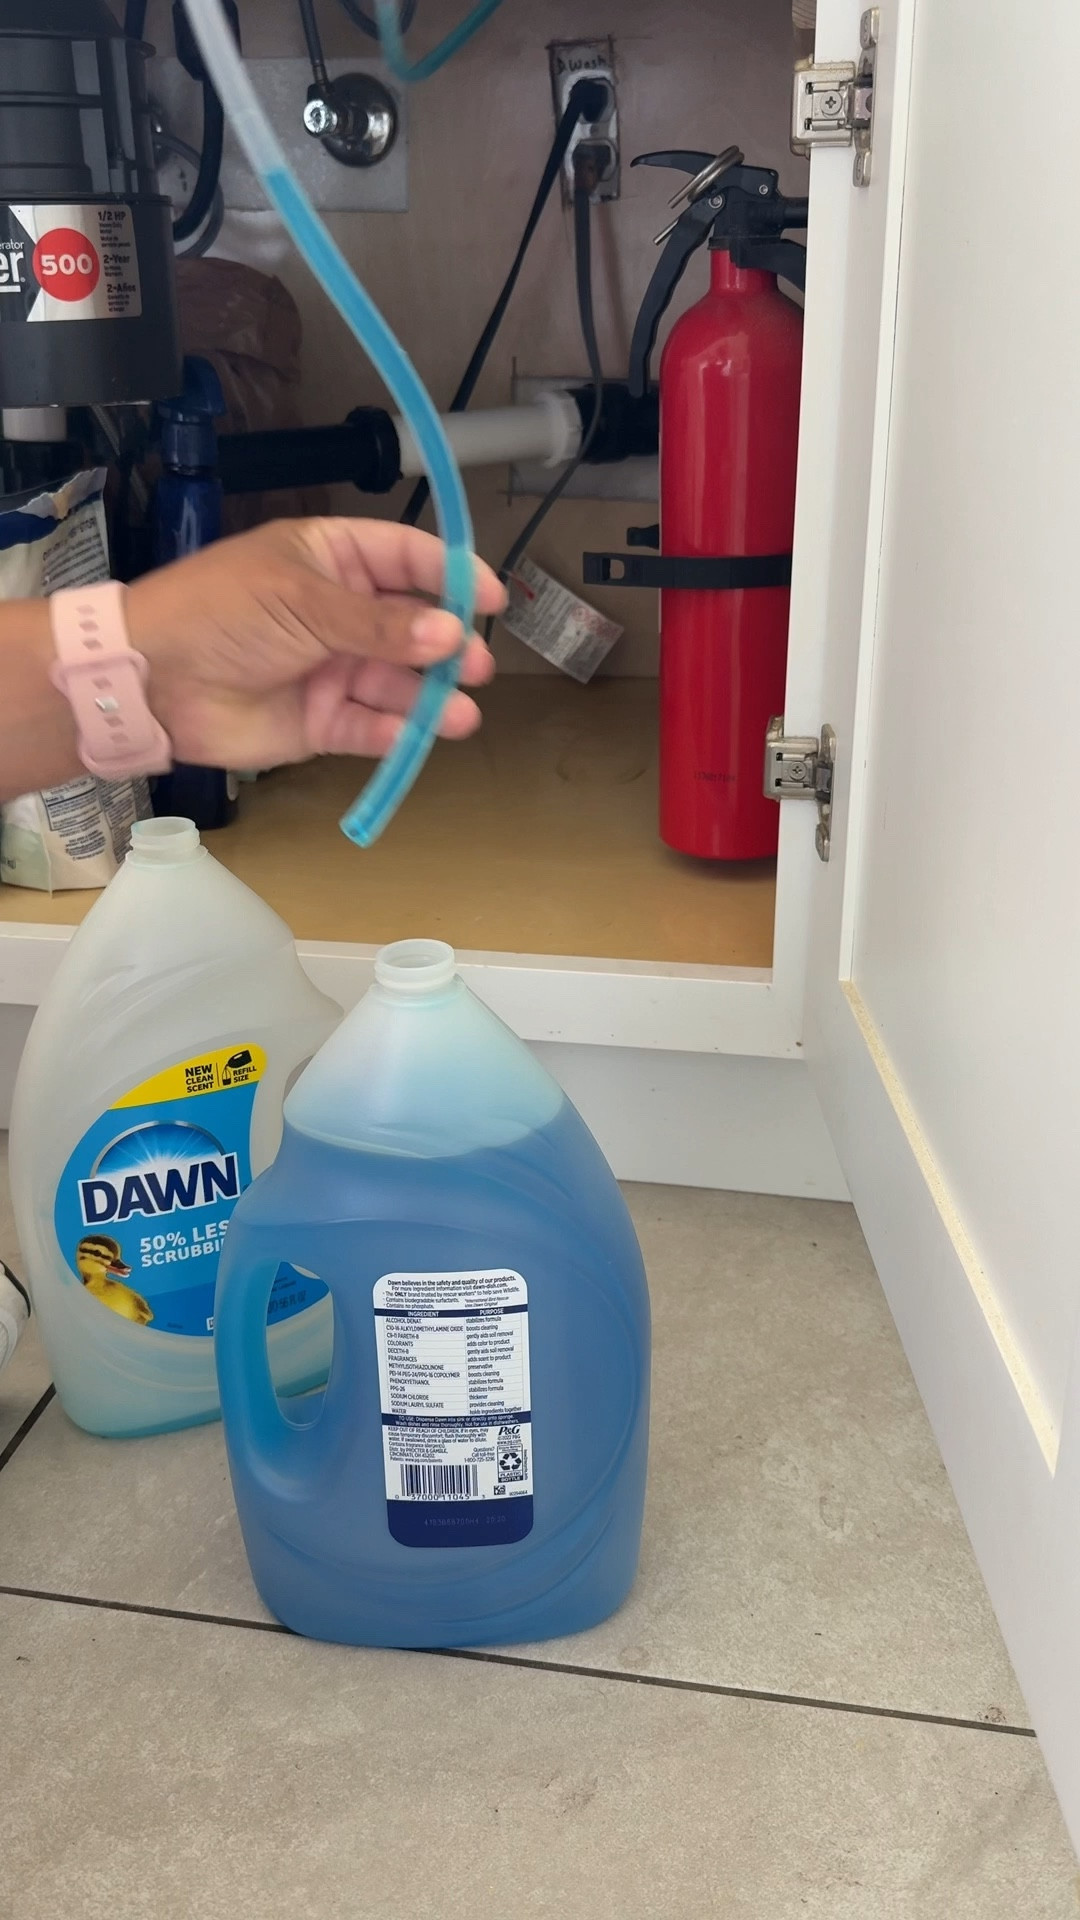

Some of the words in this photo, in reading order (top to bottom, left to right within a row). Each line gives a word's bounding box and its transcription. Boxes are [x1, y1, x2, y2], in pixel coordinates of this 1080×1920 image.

[98, 210, 113, 221] 1/2
[114, 211, 126, 221] HP
[0, 238, 24, 250] rator
[41, 253, 93, 277] 500
[103, 254, 130, 264] 2-Year
[185, 1064, 212, 1077] NEW
[233, 1066, 257, 1076] REFILL
[186, 1074, 213, 1085] CLEAN
[234, 1074, 249, 1083] SIZE
[187, 1081, 214, 1093] SCENT
[80, 1153, 239, 1224] DAWN
[140, 1232, 186, 1253] 50%
[141, 1239, 225, 1267] SCRUBBI
[499, 1425, 520, 1435] P&G
